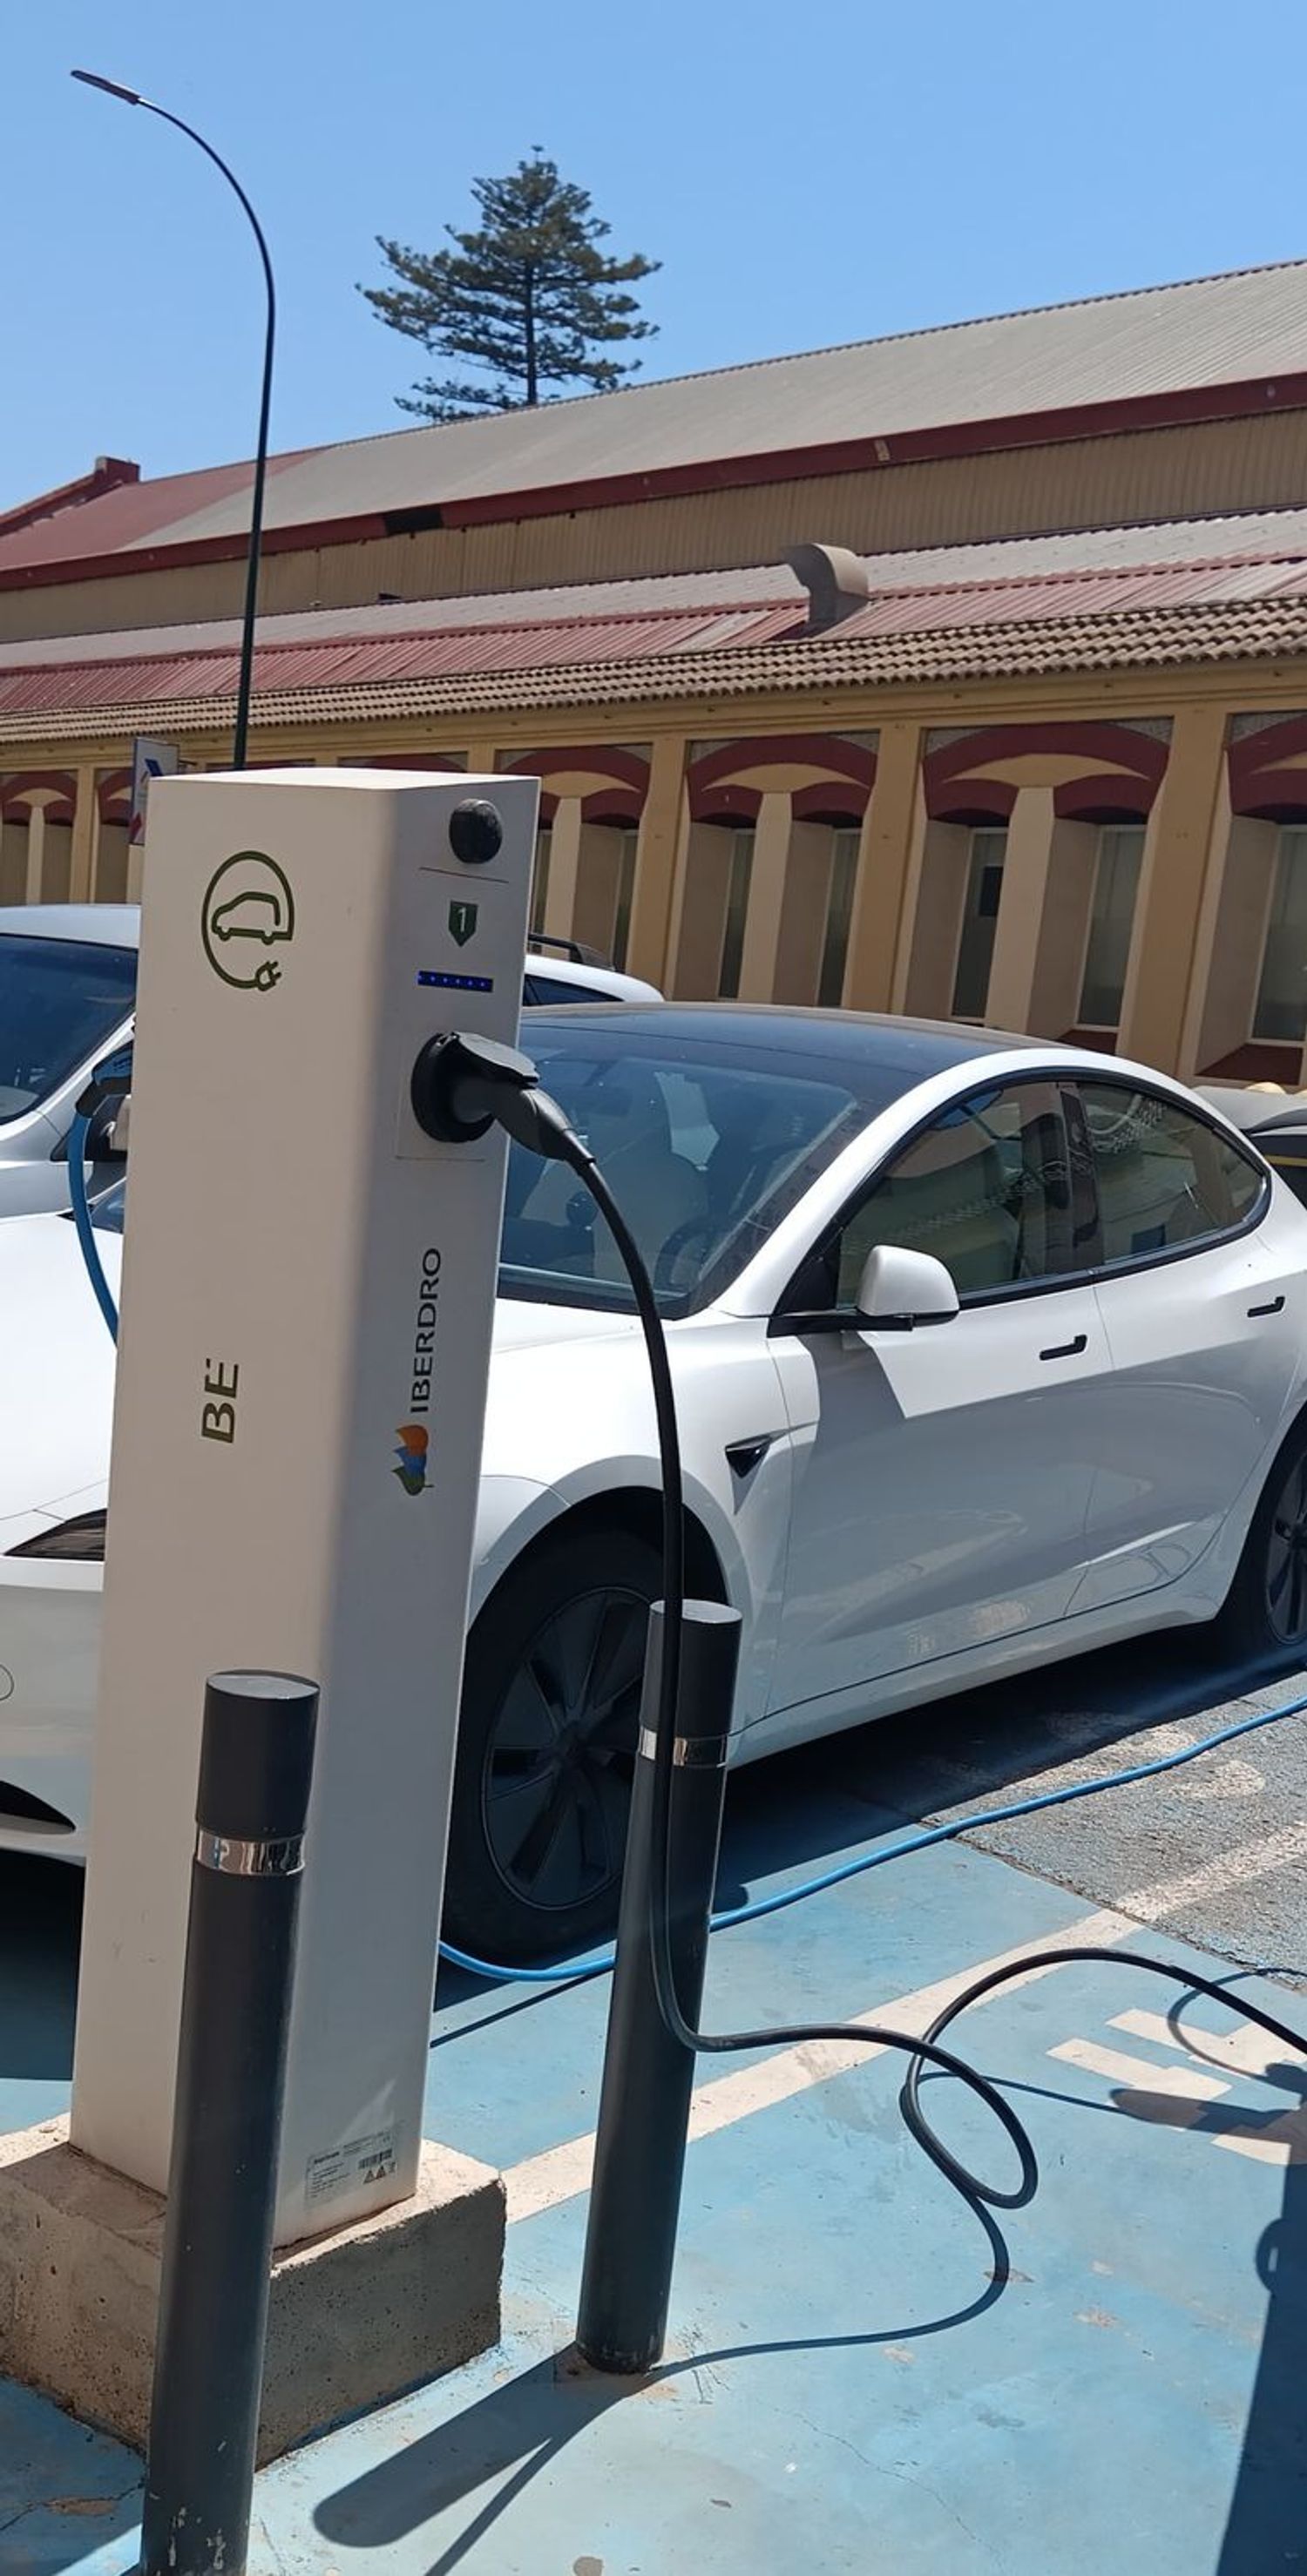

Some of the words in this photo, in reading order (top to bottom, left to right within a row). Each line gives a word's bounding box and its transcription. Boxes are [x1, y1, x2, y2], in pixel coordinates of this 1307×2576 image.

[458, 907, 467, 932] 1
[410, 1247, 442, 1413] IBERDRO
[201, 1358, 239, 1444] BE
